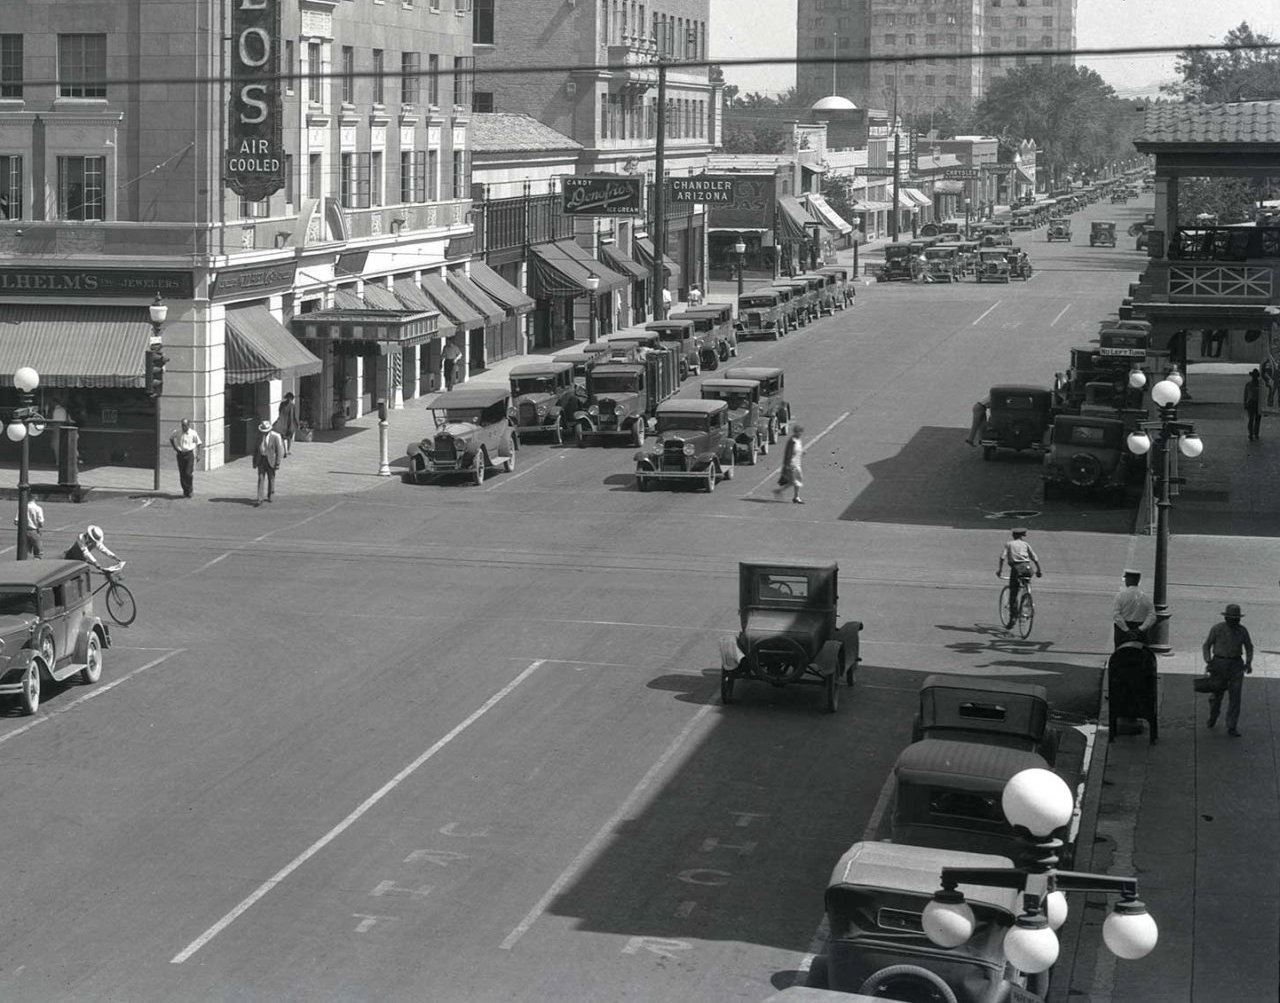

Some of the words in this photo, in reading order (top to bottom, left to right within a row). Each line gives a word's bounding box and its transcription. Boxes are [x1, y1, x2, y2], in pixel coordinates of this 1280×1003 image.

[240, 139, 269, 154] AIR
[229, 158, 280, 172] COOLED
[673, 181, 732, 190] CHANDLER
[677, 192, 728, 200] ARIZONA
[120, 279, 180, 289] JEWELERS
